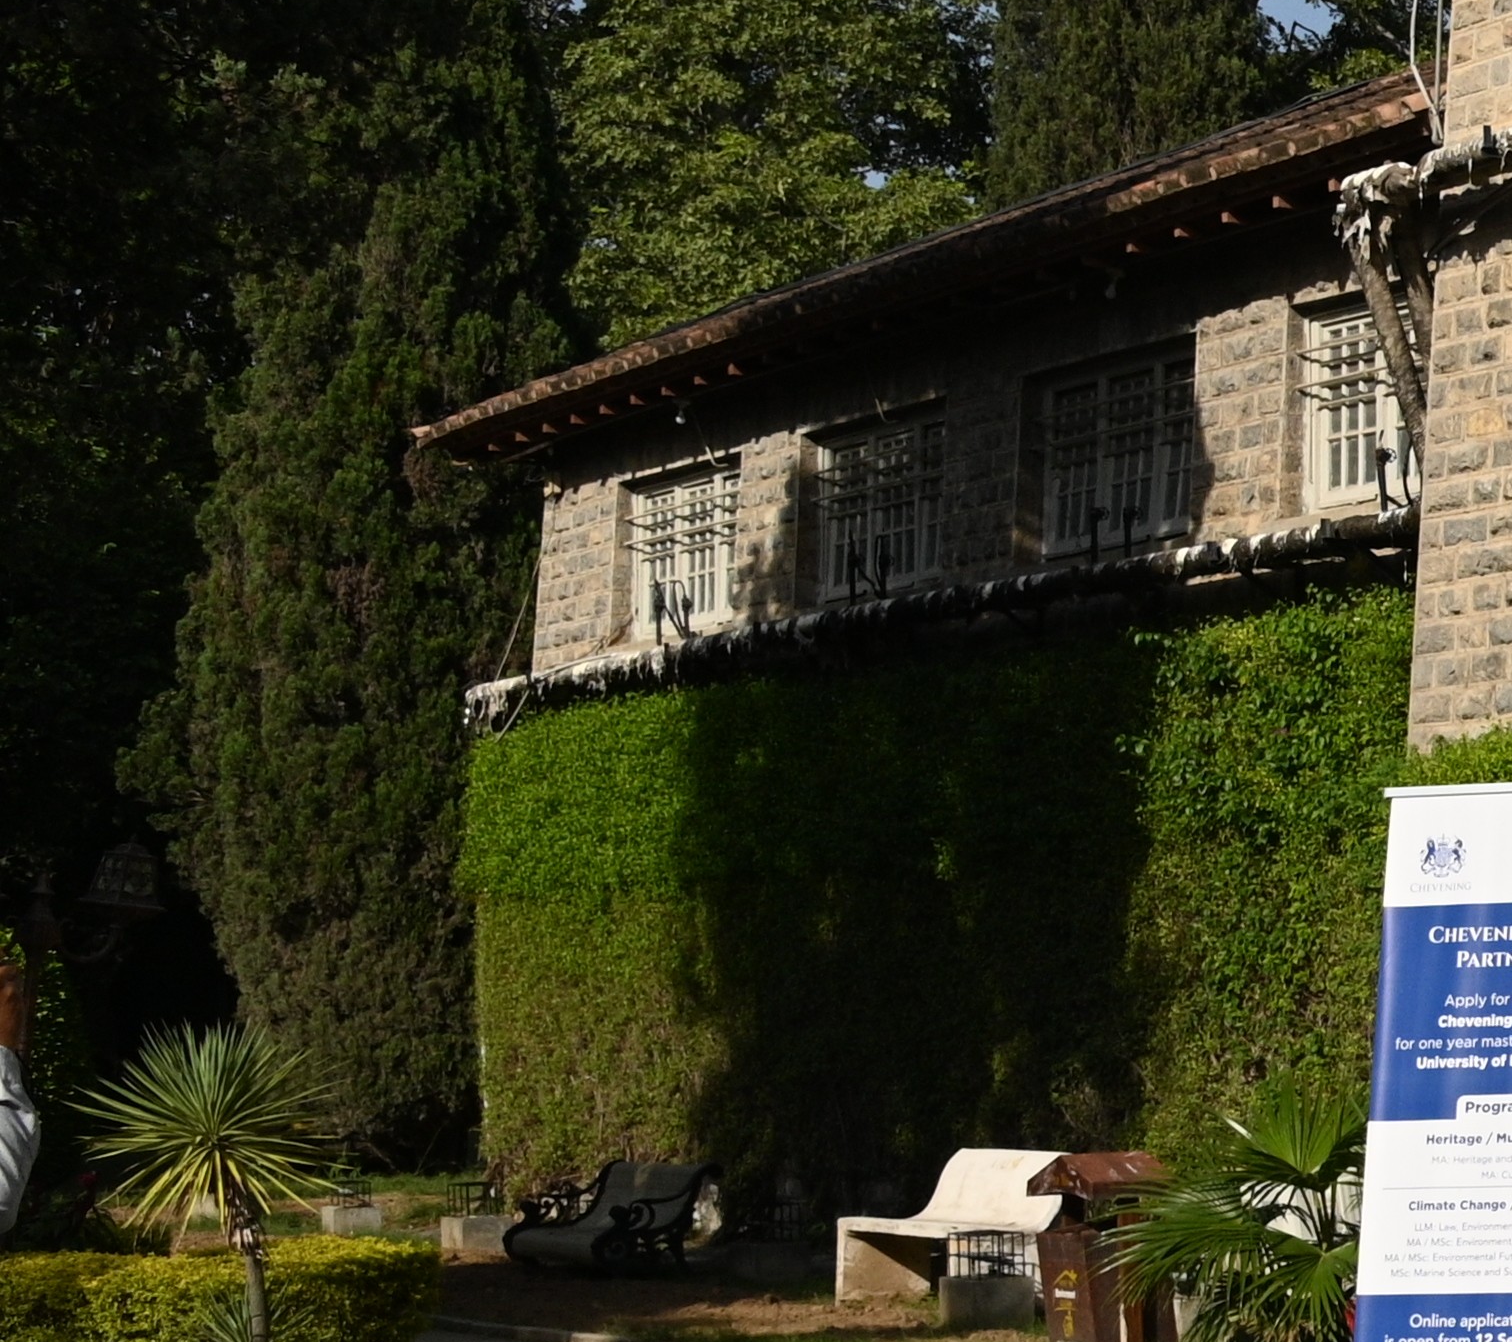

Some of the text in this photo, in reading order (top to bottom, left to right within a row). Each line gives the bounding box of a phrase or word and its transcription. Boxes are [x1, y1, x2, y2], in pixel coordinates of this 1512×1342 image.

[1410, 881, 1471, 893] CHEVENING
[1444, 993, 1486, 1009] Apply
[1491, 992, 1510, 1006] for
[1438, 1014, 1512, 1028] Chevening
[1395, 1037, 1415, 1050] for
[1419, 1039, 1442, 1049] one
[1447, 1038, 1477, 1051] year
[1416, 1055, 1488, 1070] University
[1491, 1054, 1507, 1067] of
[1426, 1134, 1482, 1146] Heritage
[1486, 1132, 1494, 1145] /
[1453, 1155, 1493, 1164] Heritage
[1496, 1154, 1512, 1162] and
[1409, 1200, 1456, 1211] Climate
[1460, 1200, 1506, 1212] Change
[1407, 1238, 1421, 1246] MA
[1385, 1254, 1399, 1262] MA
[1433, 1252, 1496, 1261] Environmental
[1448, 1268, 1481, 1276] Science
[1484, 1268, 1501, 1276] and
[1410, 1314, 1457, 1328] Online
